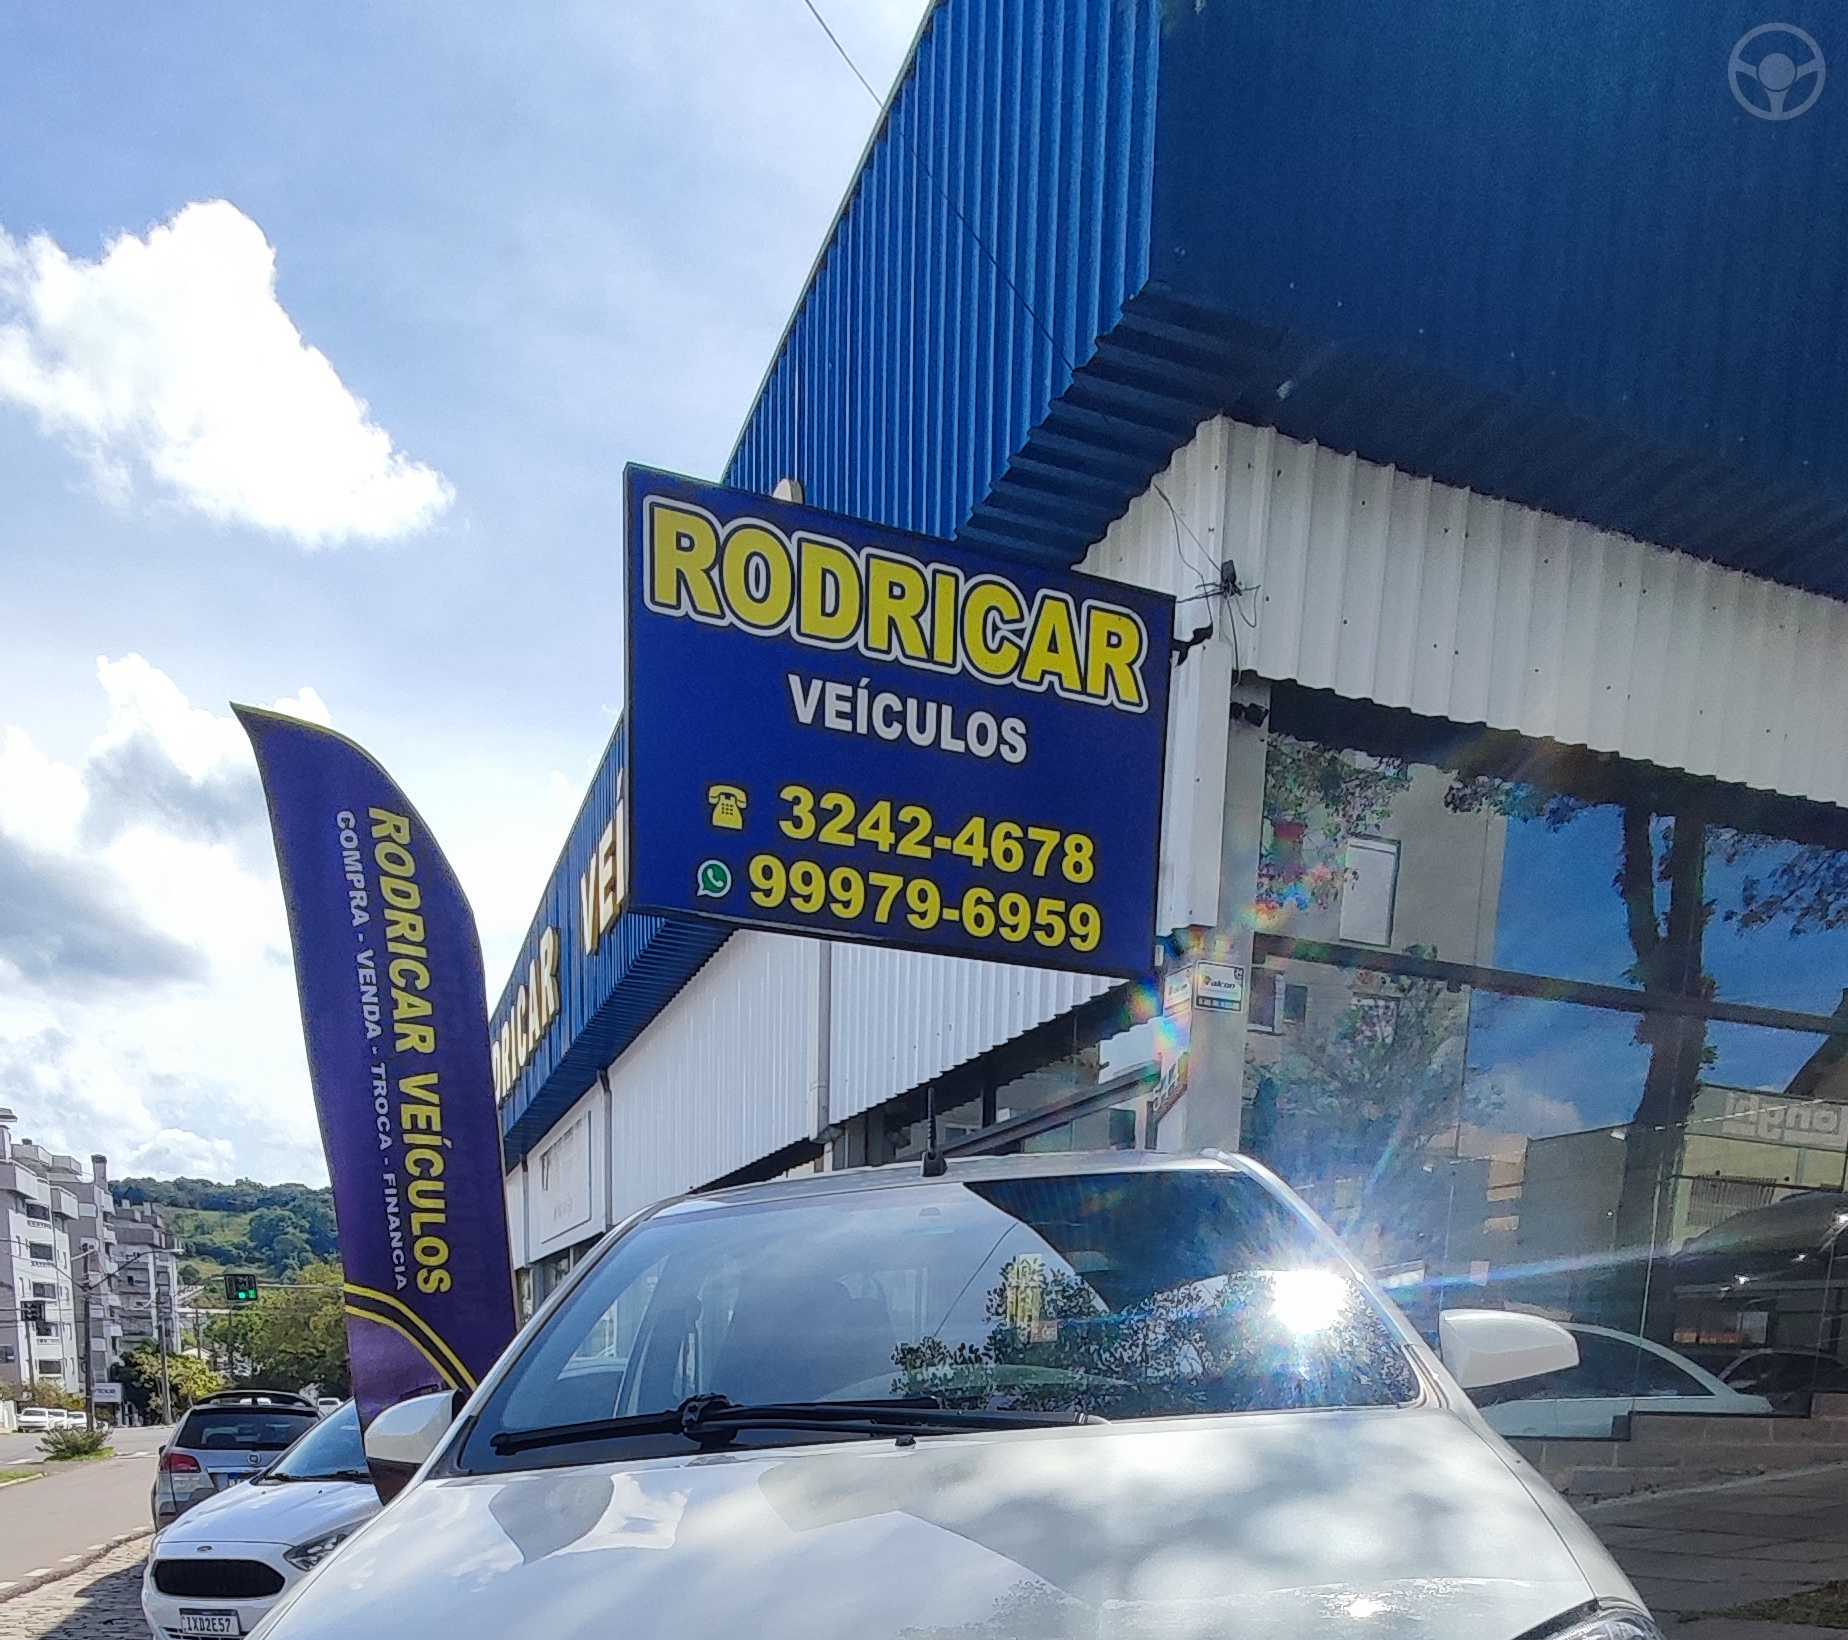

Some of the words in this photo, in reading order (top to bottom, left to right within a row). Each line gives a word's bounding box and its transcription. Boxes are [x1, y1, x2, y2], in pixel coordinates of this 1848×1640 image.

[646, 502, 1145, 709] RODRICAR
[787, 674, 1028, 764] VEÍCULOS
[367, 805, 436, 1055] RODRICAR
[747, 853, 1102, 953] 99979-6959
[777, 784, 1095, 885] 3242-4678
[336, 810, 371, 928] COMPRA
[355, 948, 383, 1041] VENDA
[370, 1062, 393, 1151] TROCA
[382, 1172, 409, 1292] FINANCIA
[398, 1072, 453, 1295] VEÍCULOS
